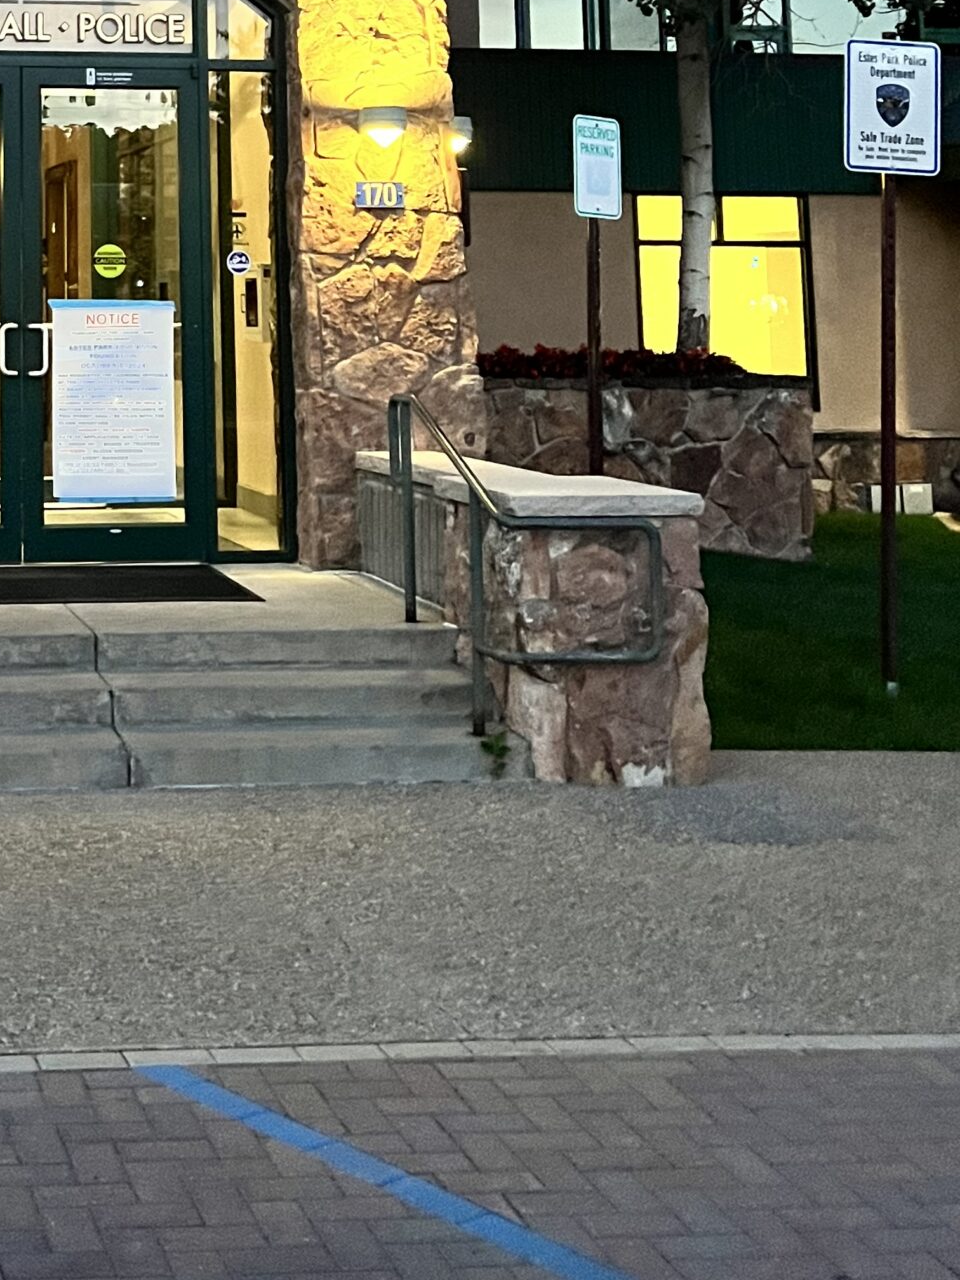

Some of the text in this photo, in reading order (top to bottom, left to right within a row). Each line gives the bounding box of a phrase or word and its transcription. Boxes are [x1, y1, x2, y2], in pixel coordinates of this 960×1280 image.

[78, 12, 186, 45] POLICE
[858, 51, 927, 67] Estes Park Police
[870, 65, 916, 79] Department
[577, 125, 617, 142] RESERVED
[860, 131, 925, 145] Safe Trade Zone
[580, 142, 614, 158] PARKING
[362, 182, 398, 207] 170
[86, 313, 140, 325] NOTICE
